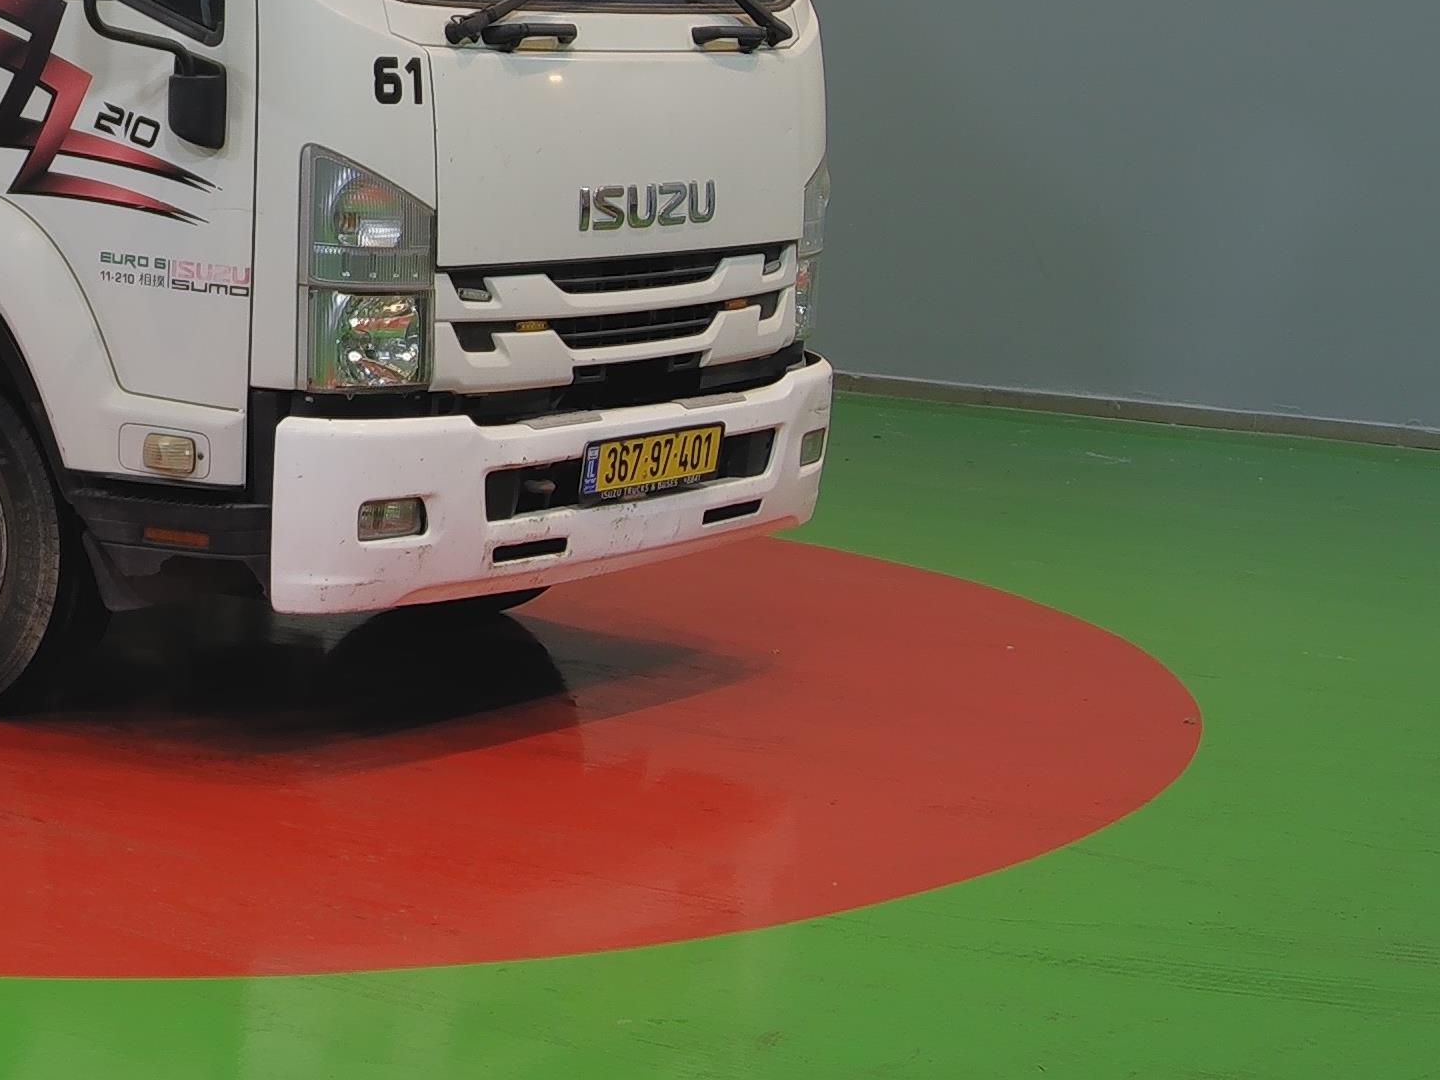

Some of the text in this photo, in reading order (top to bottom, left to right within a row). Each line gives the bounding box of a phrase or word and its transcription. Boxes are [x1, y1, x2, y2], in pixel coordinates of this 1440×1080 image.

[374, 57, 423, 104] 61
[94, 101, 160, 148] 210
[579, 179, 716, 232] ISUZU
[100, 251, 166, 270] EURO 6
[172, 259, 250, 284] ISUZU
[171, 279, 249, 297] SUMO
[601, 489, 622, 499] ISUZU
[624, 484, 649, 496] TRUCKS
